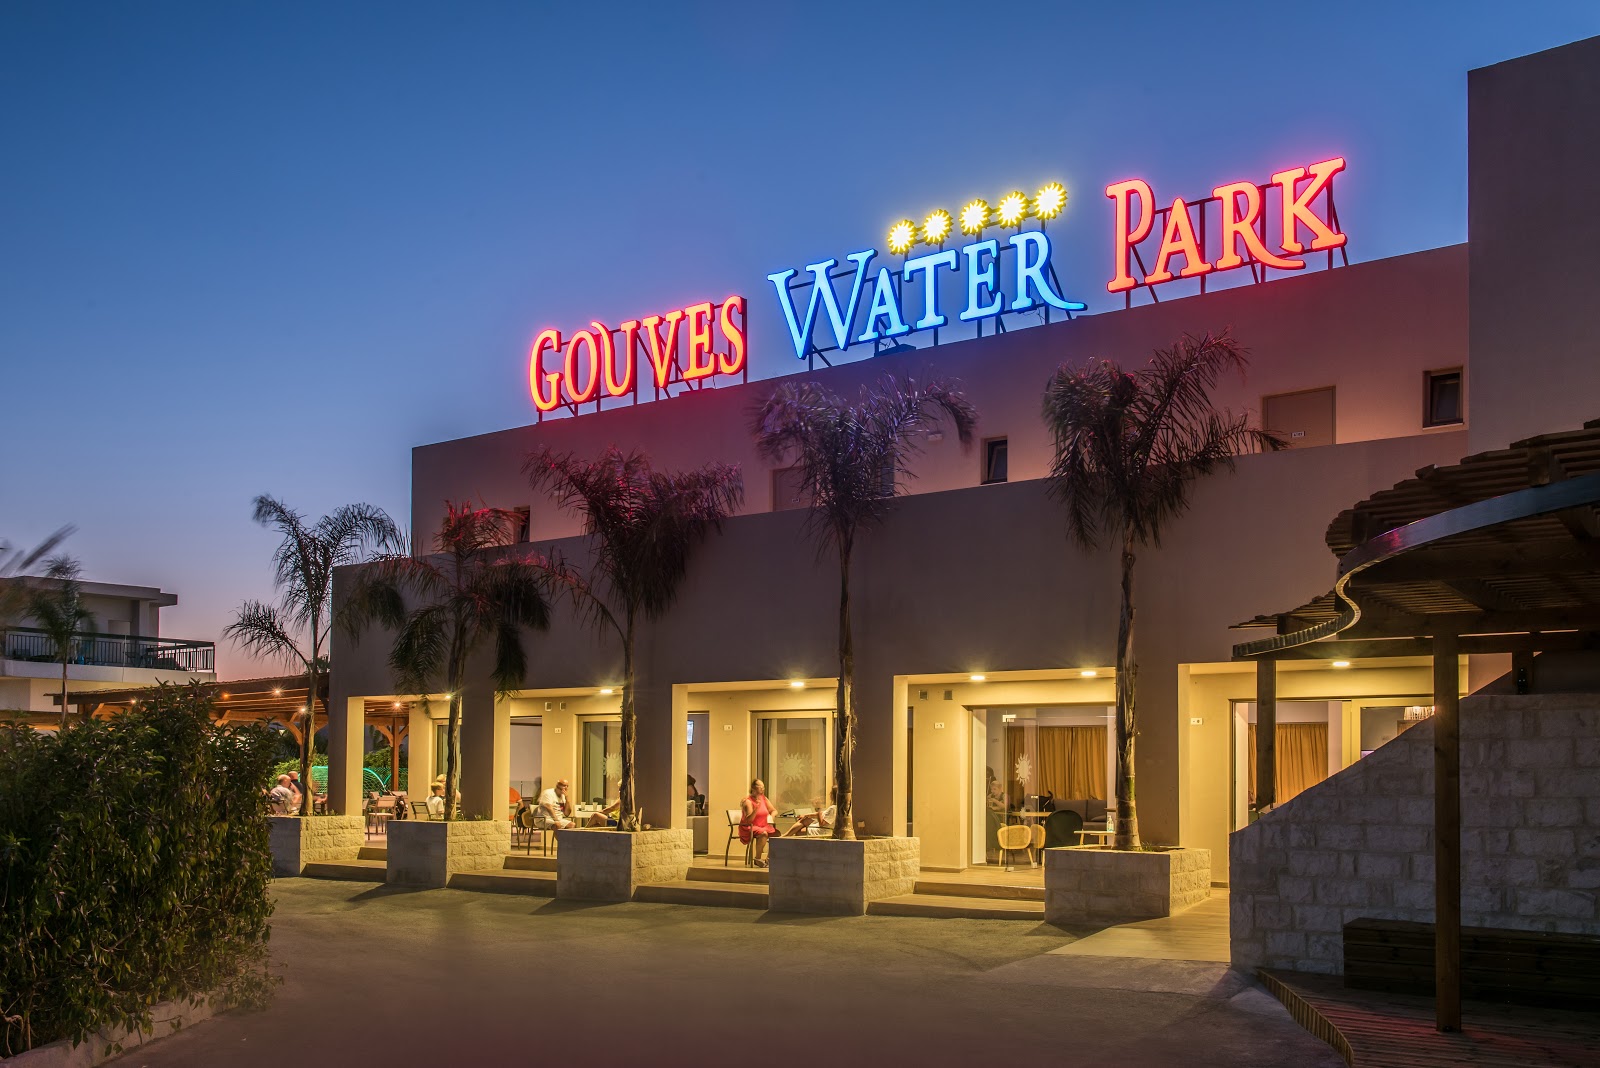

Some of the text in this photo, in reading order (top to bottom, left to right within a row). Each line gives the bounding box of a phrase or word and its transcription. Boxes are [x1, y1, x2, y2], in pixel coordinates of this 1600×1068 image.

[529, 157, 1347, 411] GOUVES WATER PARK
